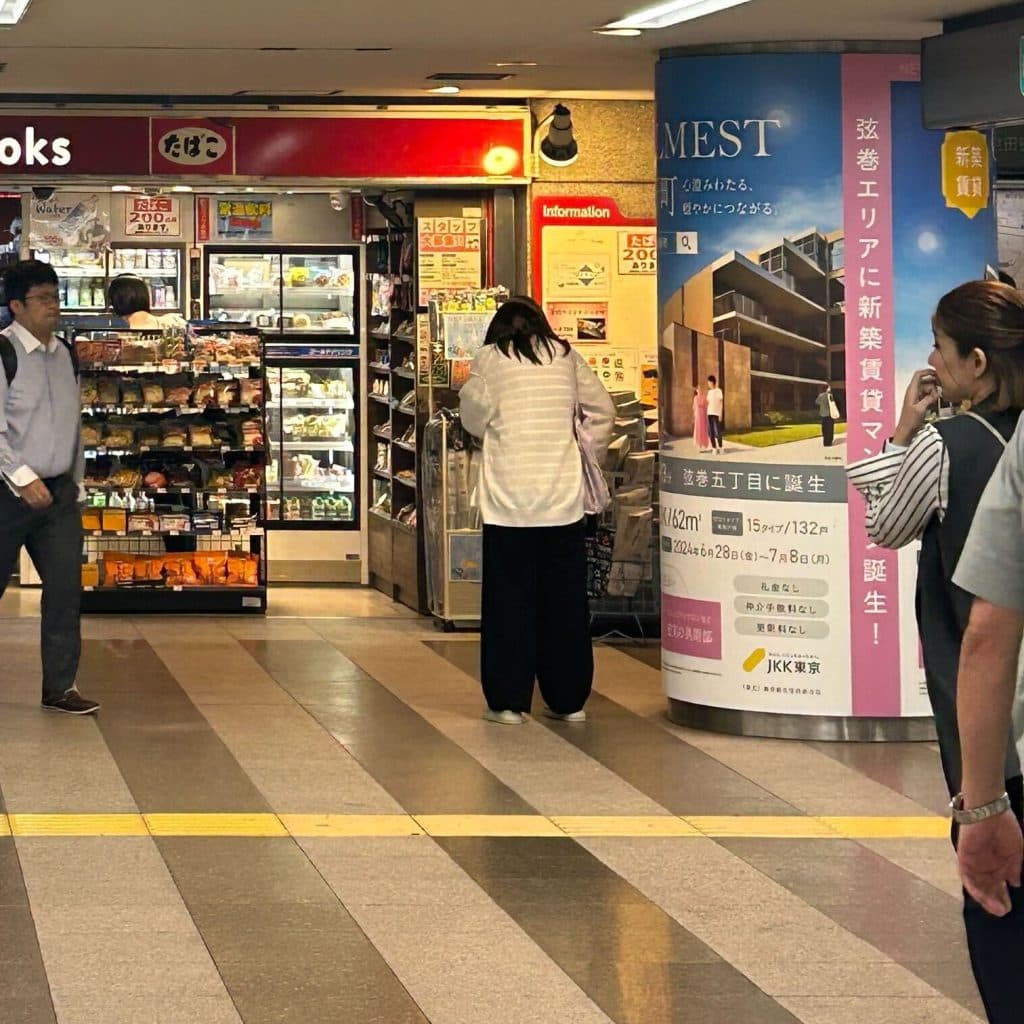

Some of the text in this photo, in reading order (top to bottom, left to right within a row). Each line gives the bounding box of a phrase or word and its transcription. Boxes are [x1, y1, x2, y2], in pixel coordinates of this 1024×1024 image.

[164, 133, 219, 159] たばこ
[660, 119, 782, 160] MEST
